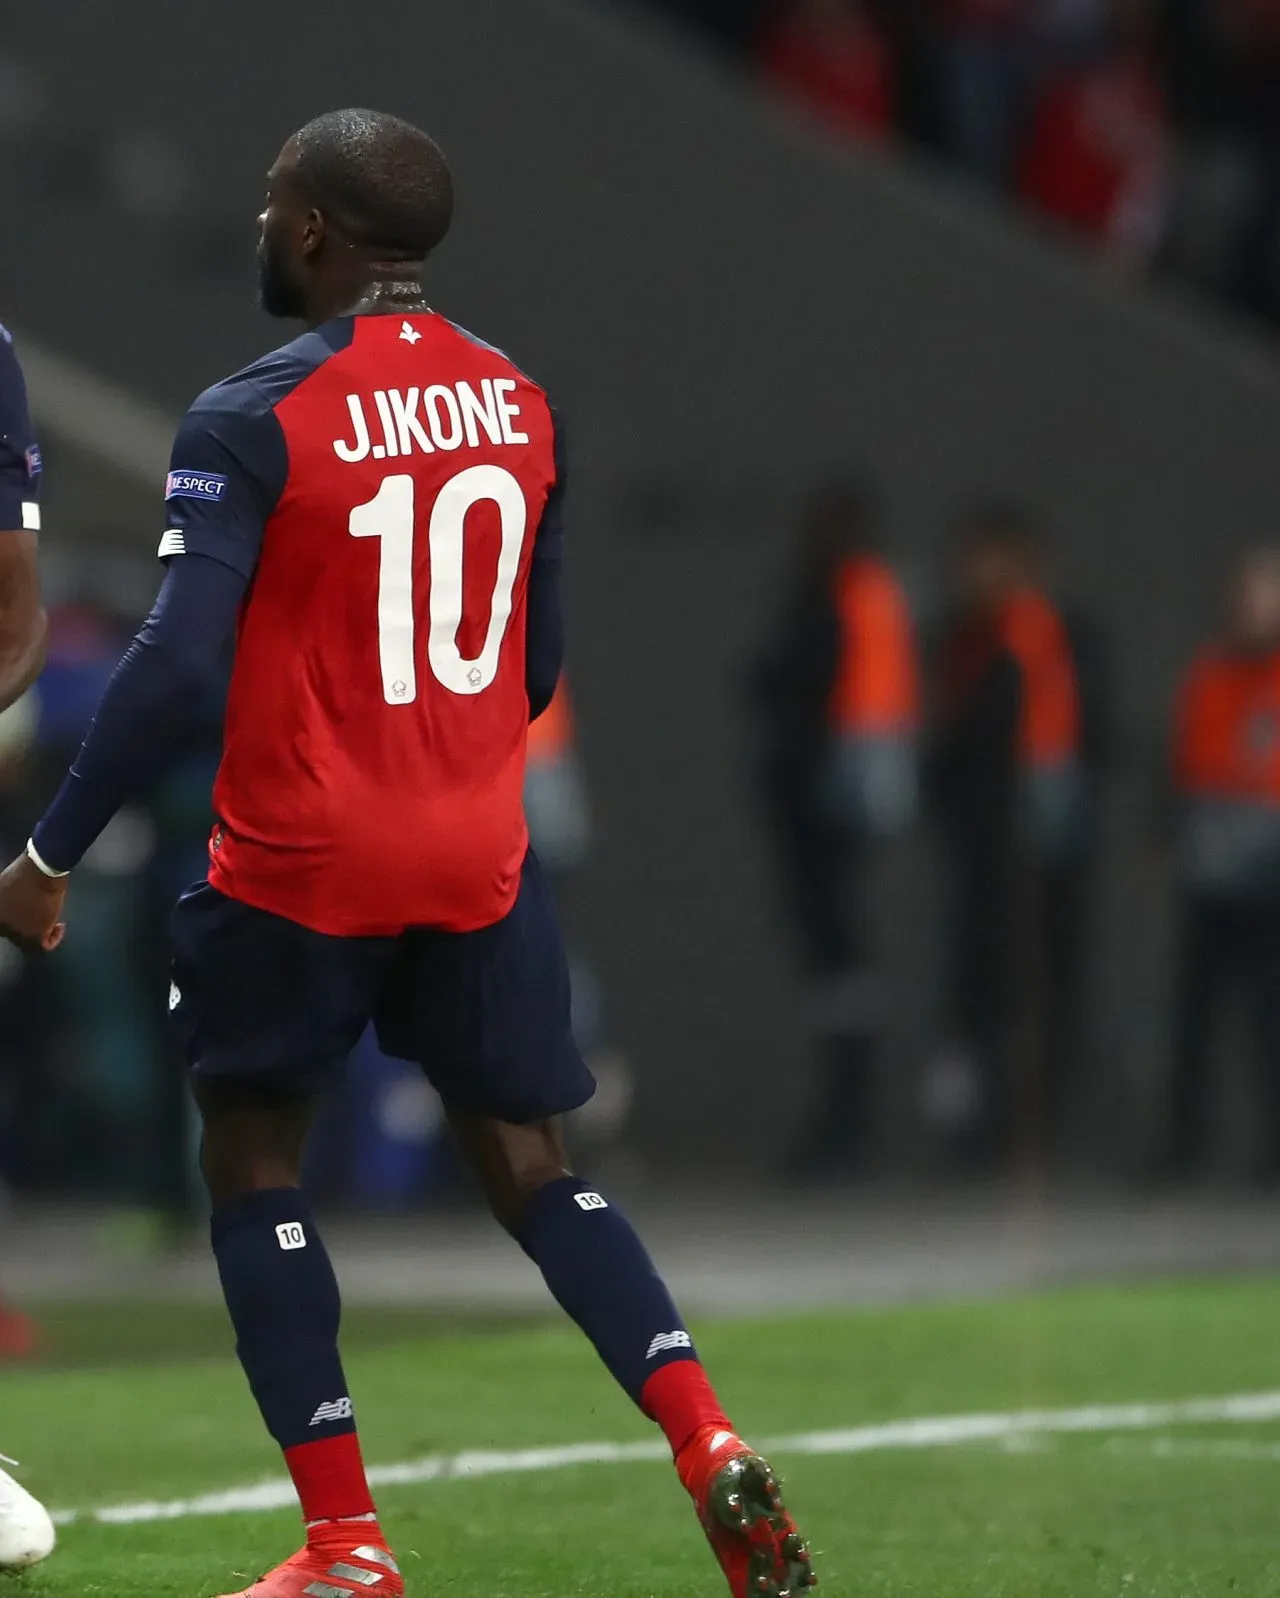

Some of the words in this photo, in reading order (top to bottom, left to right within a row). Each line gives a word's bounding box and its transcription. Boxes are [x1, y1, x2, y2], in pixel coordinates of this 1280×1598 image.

[333, 378, 529, 463] J.IKONE
[348, 464, 527, 706] 10
[580, 1195, 602, 1207] 10
[280, 1226, 302, 1245] 10
